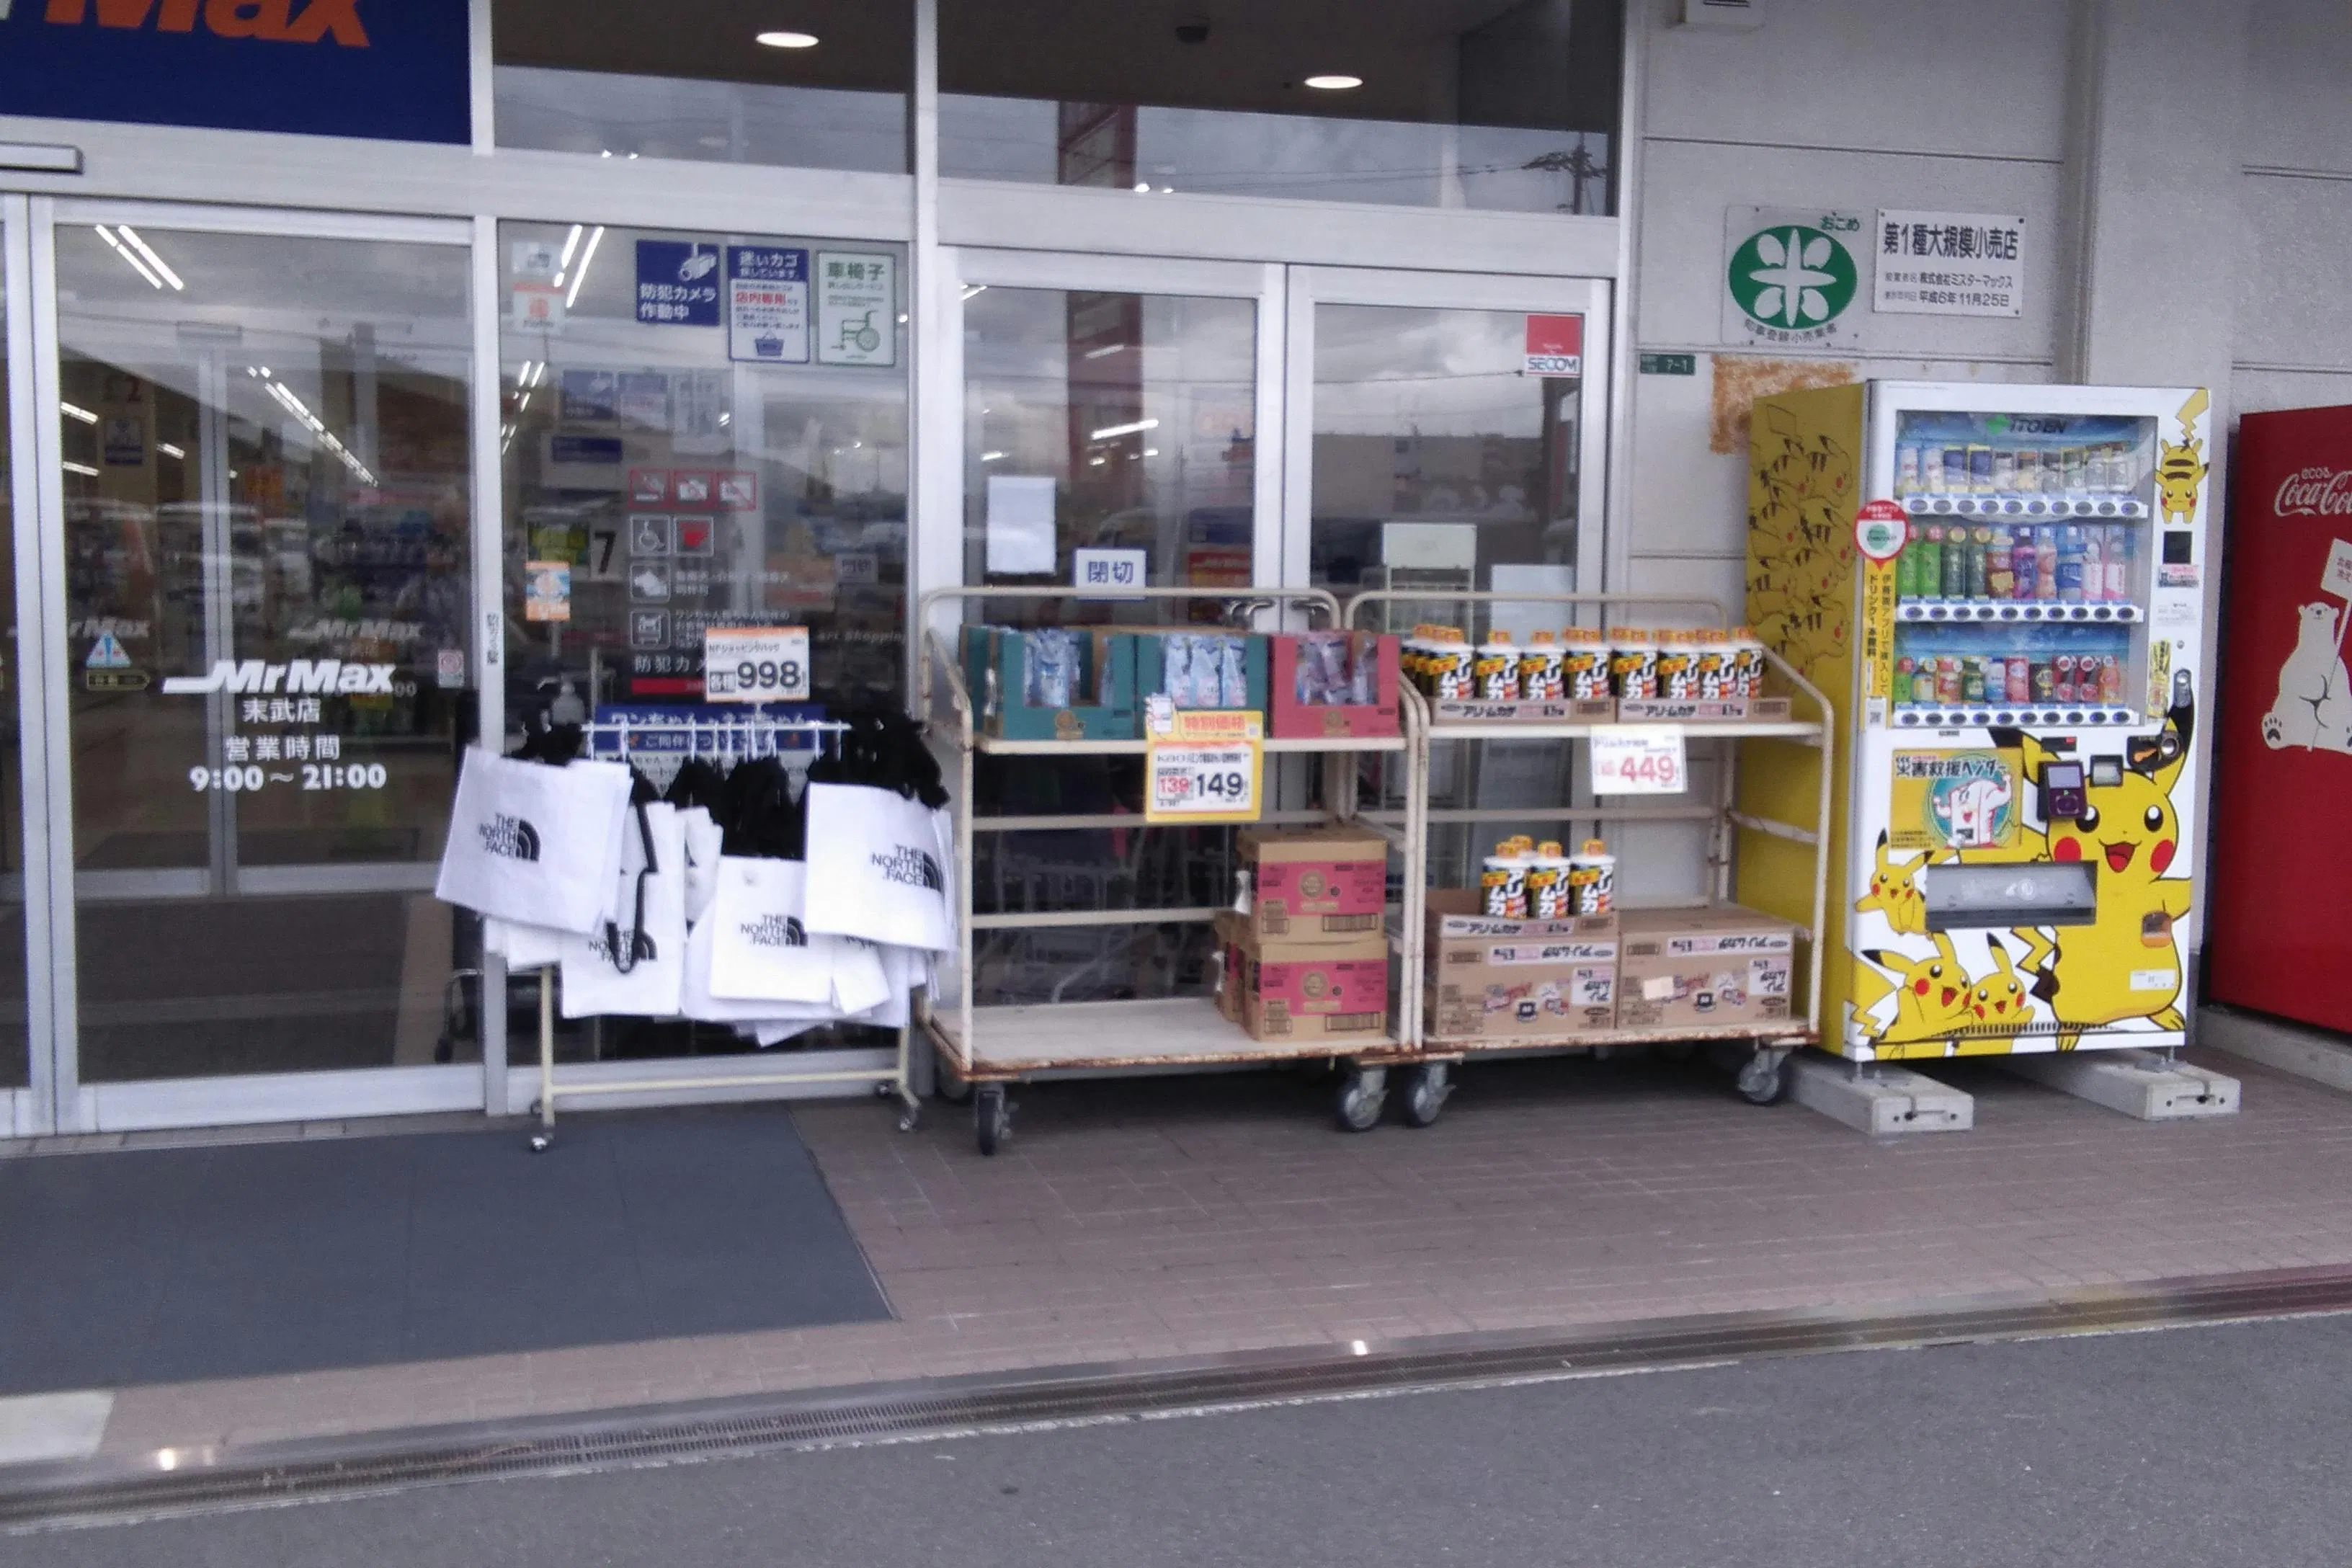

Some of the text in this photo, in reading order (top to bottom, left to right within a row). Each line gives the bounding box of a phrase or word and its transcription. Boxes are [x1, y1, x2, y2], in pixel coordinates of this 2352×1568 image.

[1819, 216, 1861, 231] おこめ
[1884, 222, 2019, 260] 第1種大規模小売店
[829, 262, 885, 281] 車椅子
[640, 282, 717, 303] 防犯カメラ
[640, 302, 690, 321] 作動中
[1528, 357, 1578, 372] SECOM
[1087, 561, 1134, 584] 閉切
[162, 659, 396, 694] MrMax
[737, 661, 801, 689] 998
[226, 735, 341, 762] 営業時間
[1620, 756, 1675, 782] 449
[1159, 778, 1189, 793] 139
[1197, 772, 1243, 797] 149
[496, 812, 519, 829] THE
[478, 823, 518, 841] NORTH
[484, 839, 515, 858] FACE
[895, 844, 923, 860] THE
[871, 852, 923, 872] NORTH
[885, 869, 923, 886] FACE
[741, 923, 787, 935] NORTH
[762, 914, 787, 926] THE
[751, 935, 786, 946] FACE
